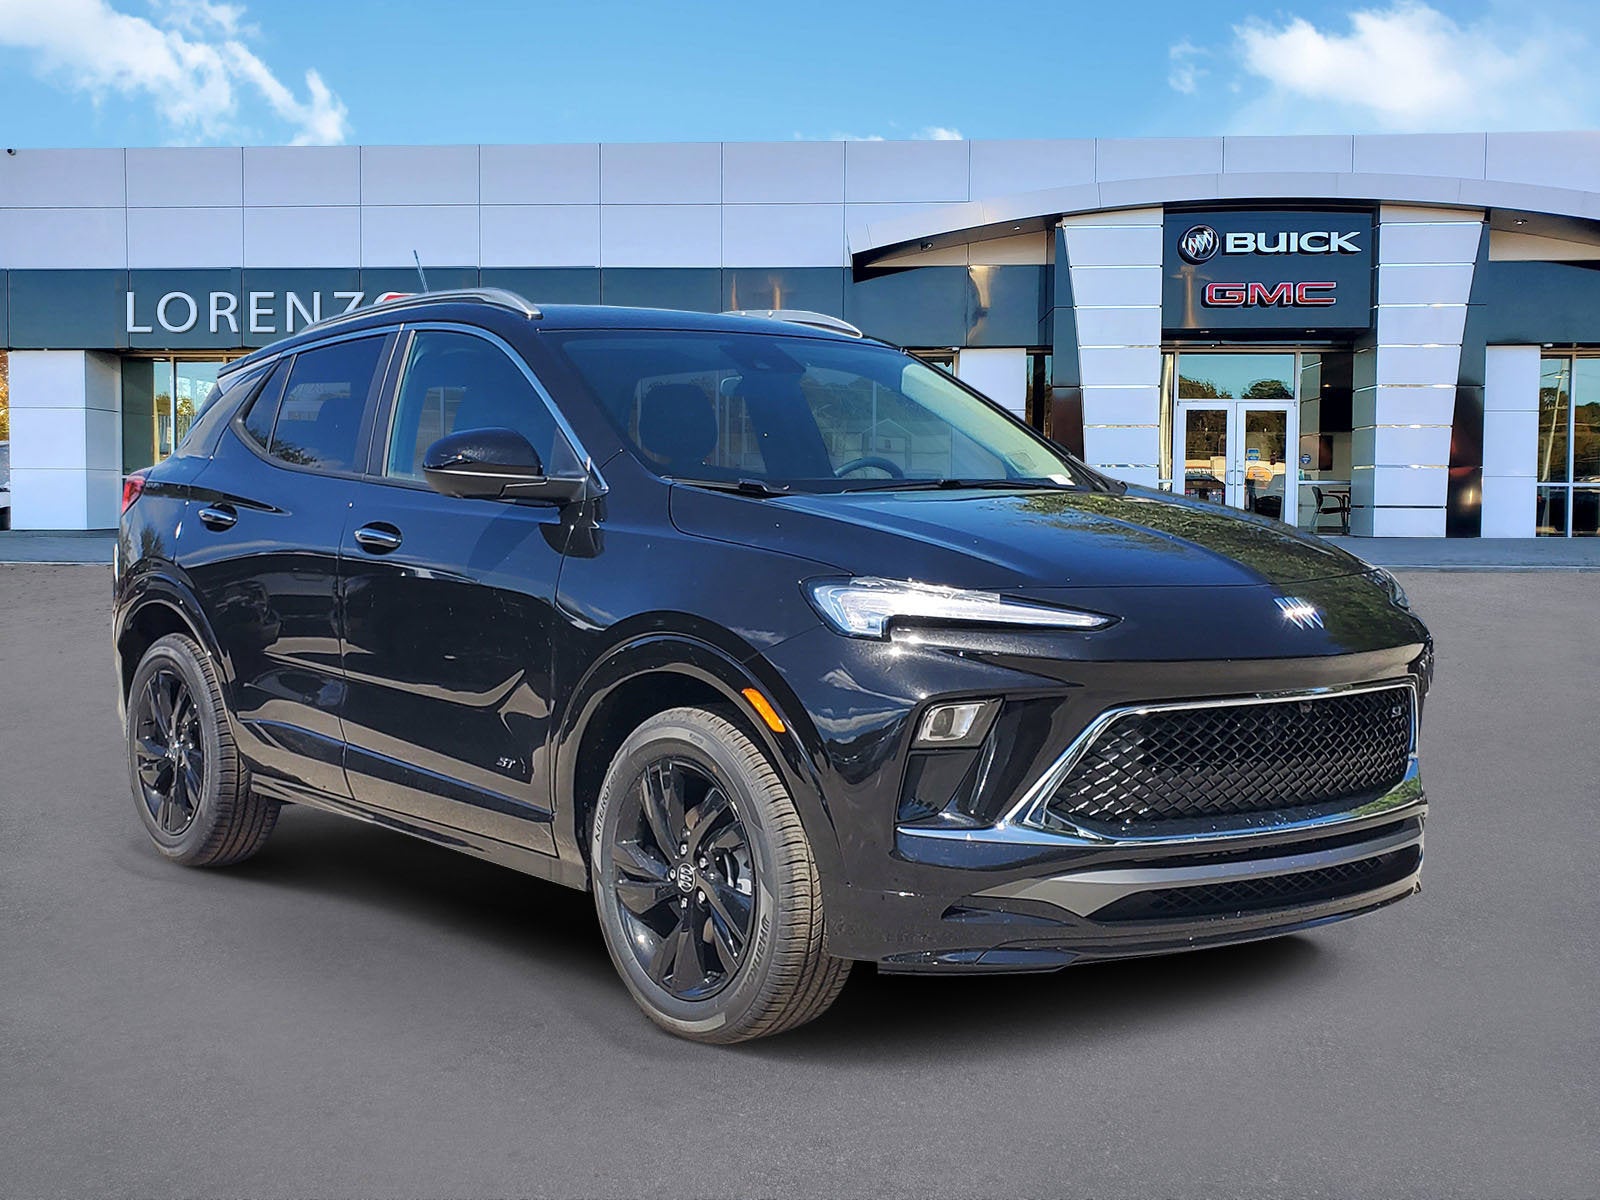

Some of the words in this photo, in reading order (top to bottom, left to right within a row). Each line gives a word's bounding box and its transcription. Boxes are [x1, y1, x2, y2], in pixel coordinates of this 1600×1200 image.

[1226, 231, 1361, 253] BUICK
[1206, 282, 1336, 305] GMC
[125, 291, 417, 333] LORENZ
